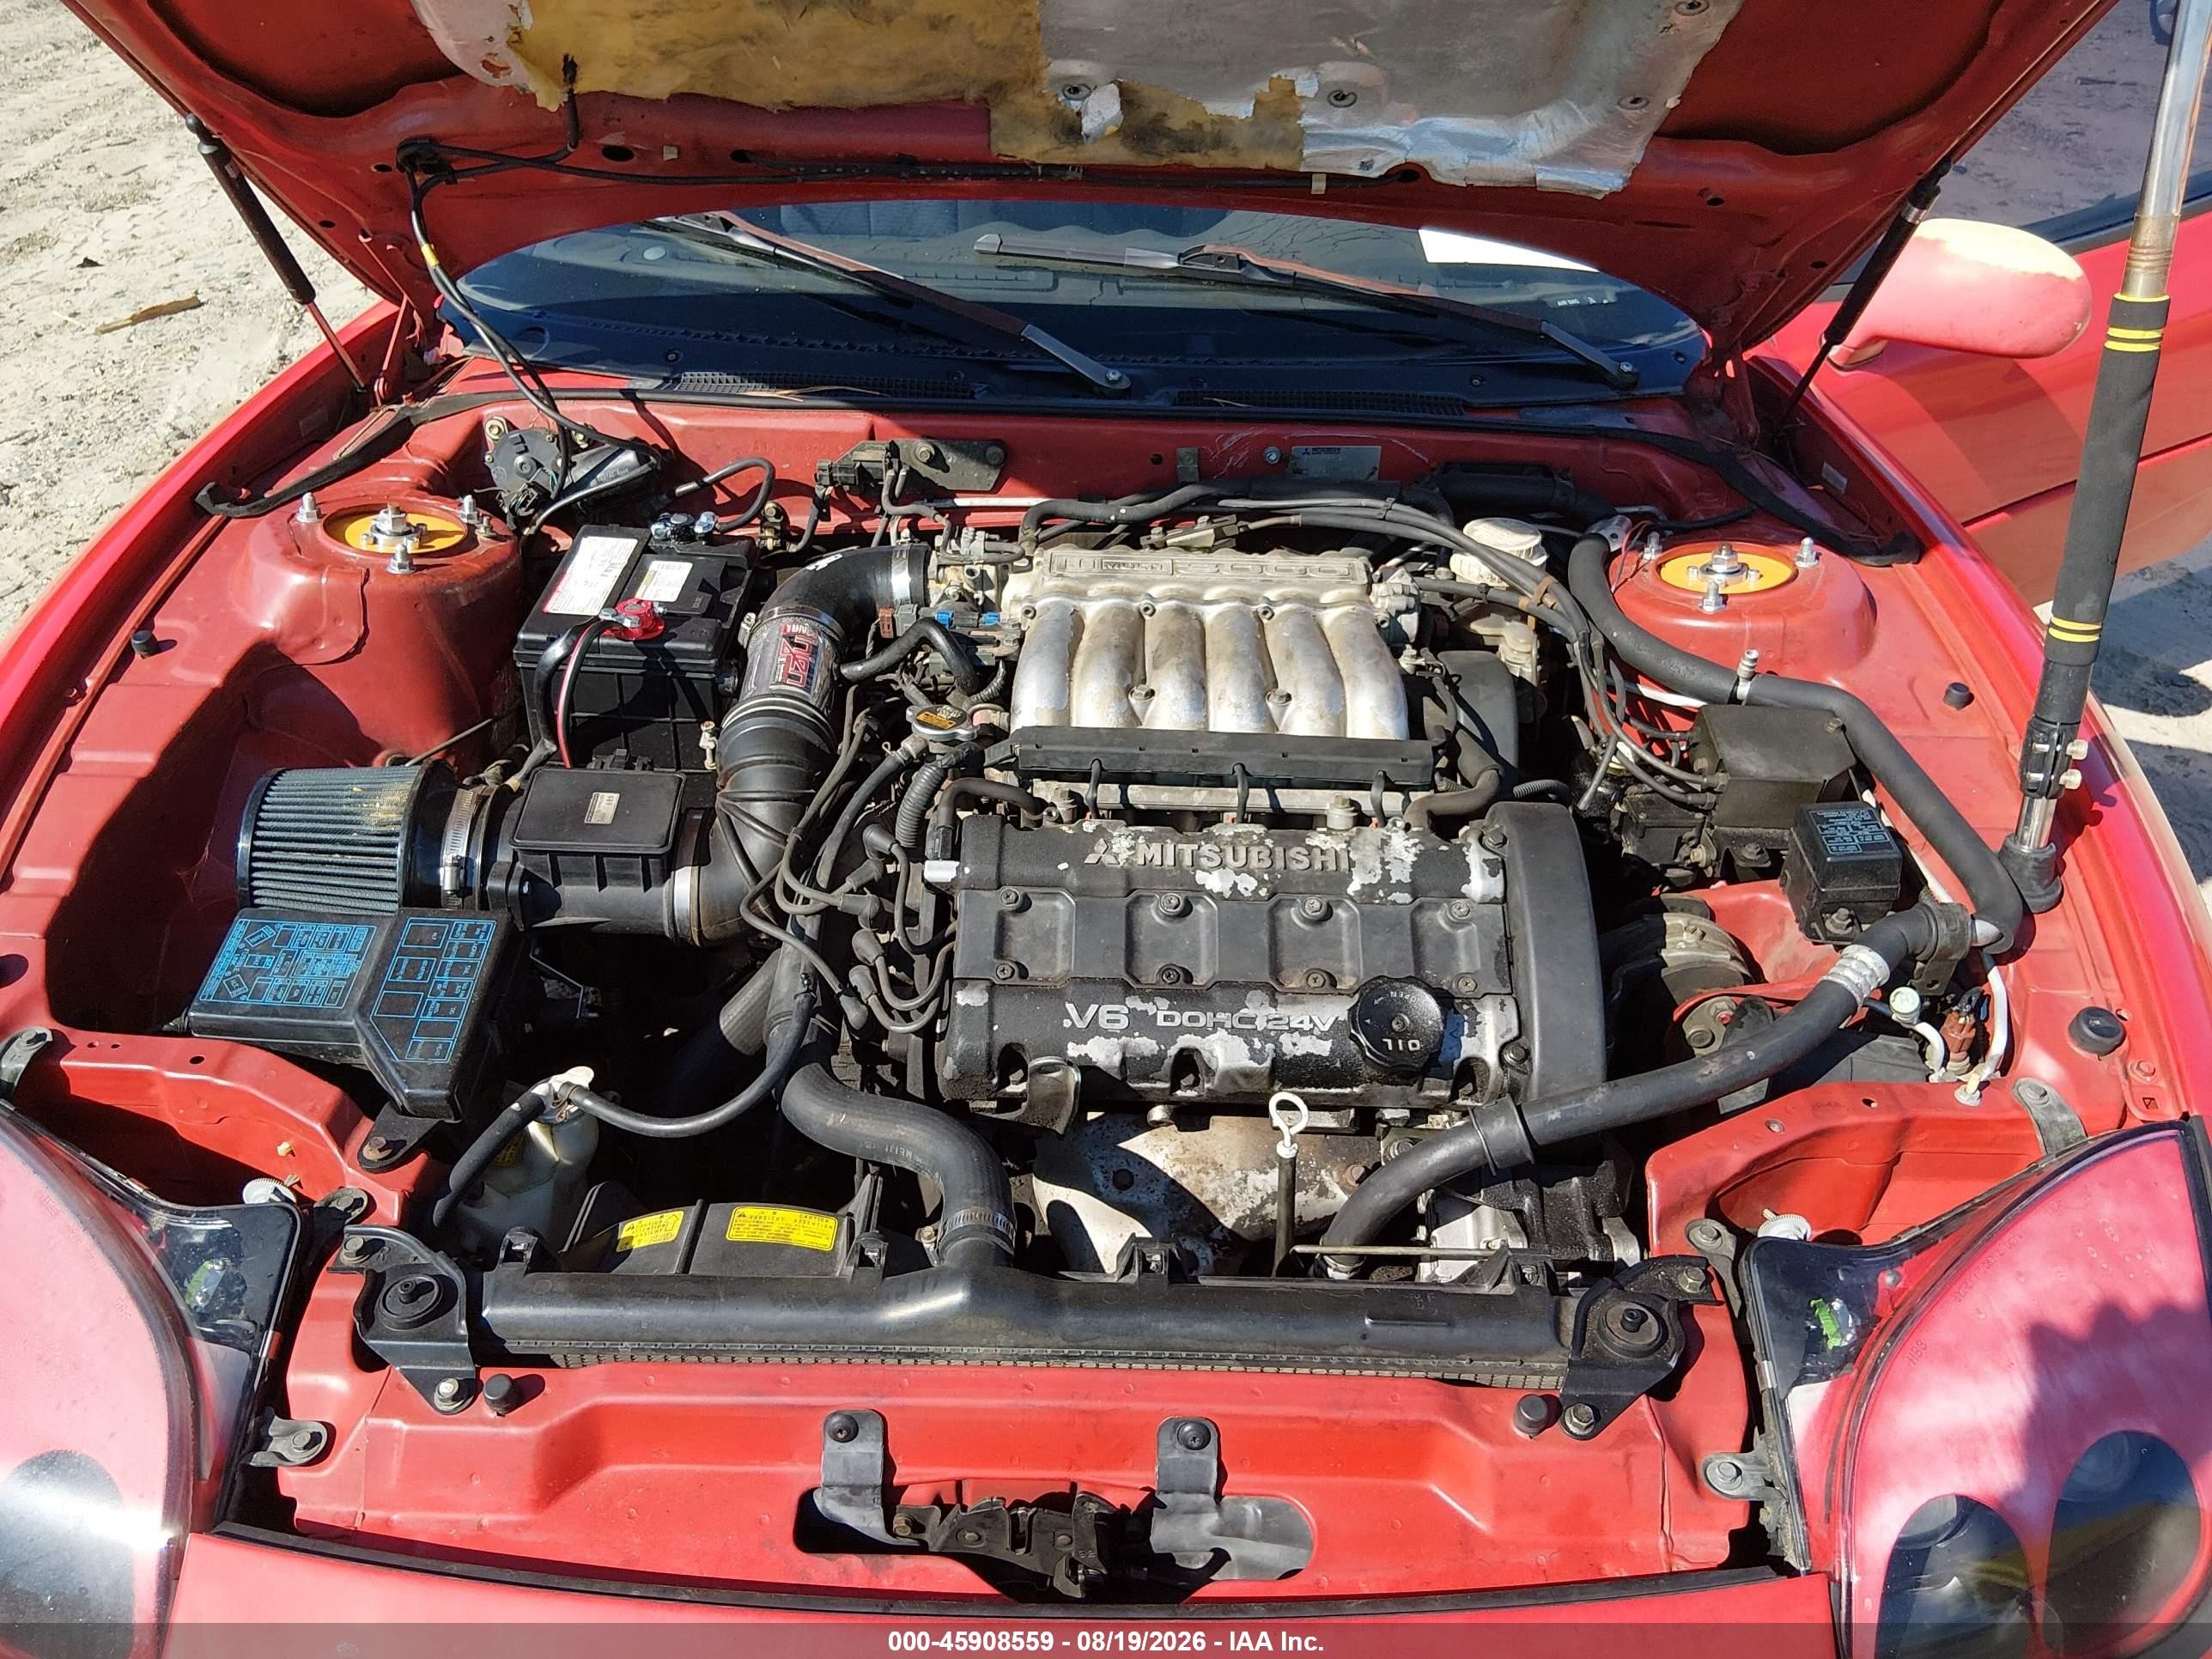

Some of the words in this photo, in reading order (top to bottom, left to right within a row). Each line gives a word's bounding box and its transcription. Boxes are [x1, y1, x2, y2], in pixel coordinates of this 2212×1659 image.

[1138, 842, 1352, 872] MITSUBISHI
[1065, 1002, 1131, 1030] V6
[1156, 1010, 1259, 1030] DOHC
[1267, 1014, 1340, 1031] 24V
[1382, 1038, 1421, 1051] OIL
